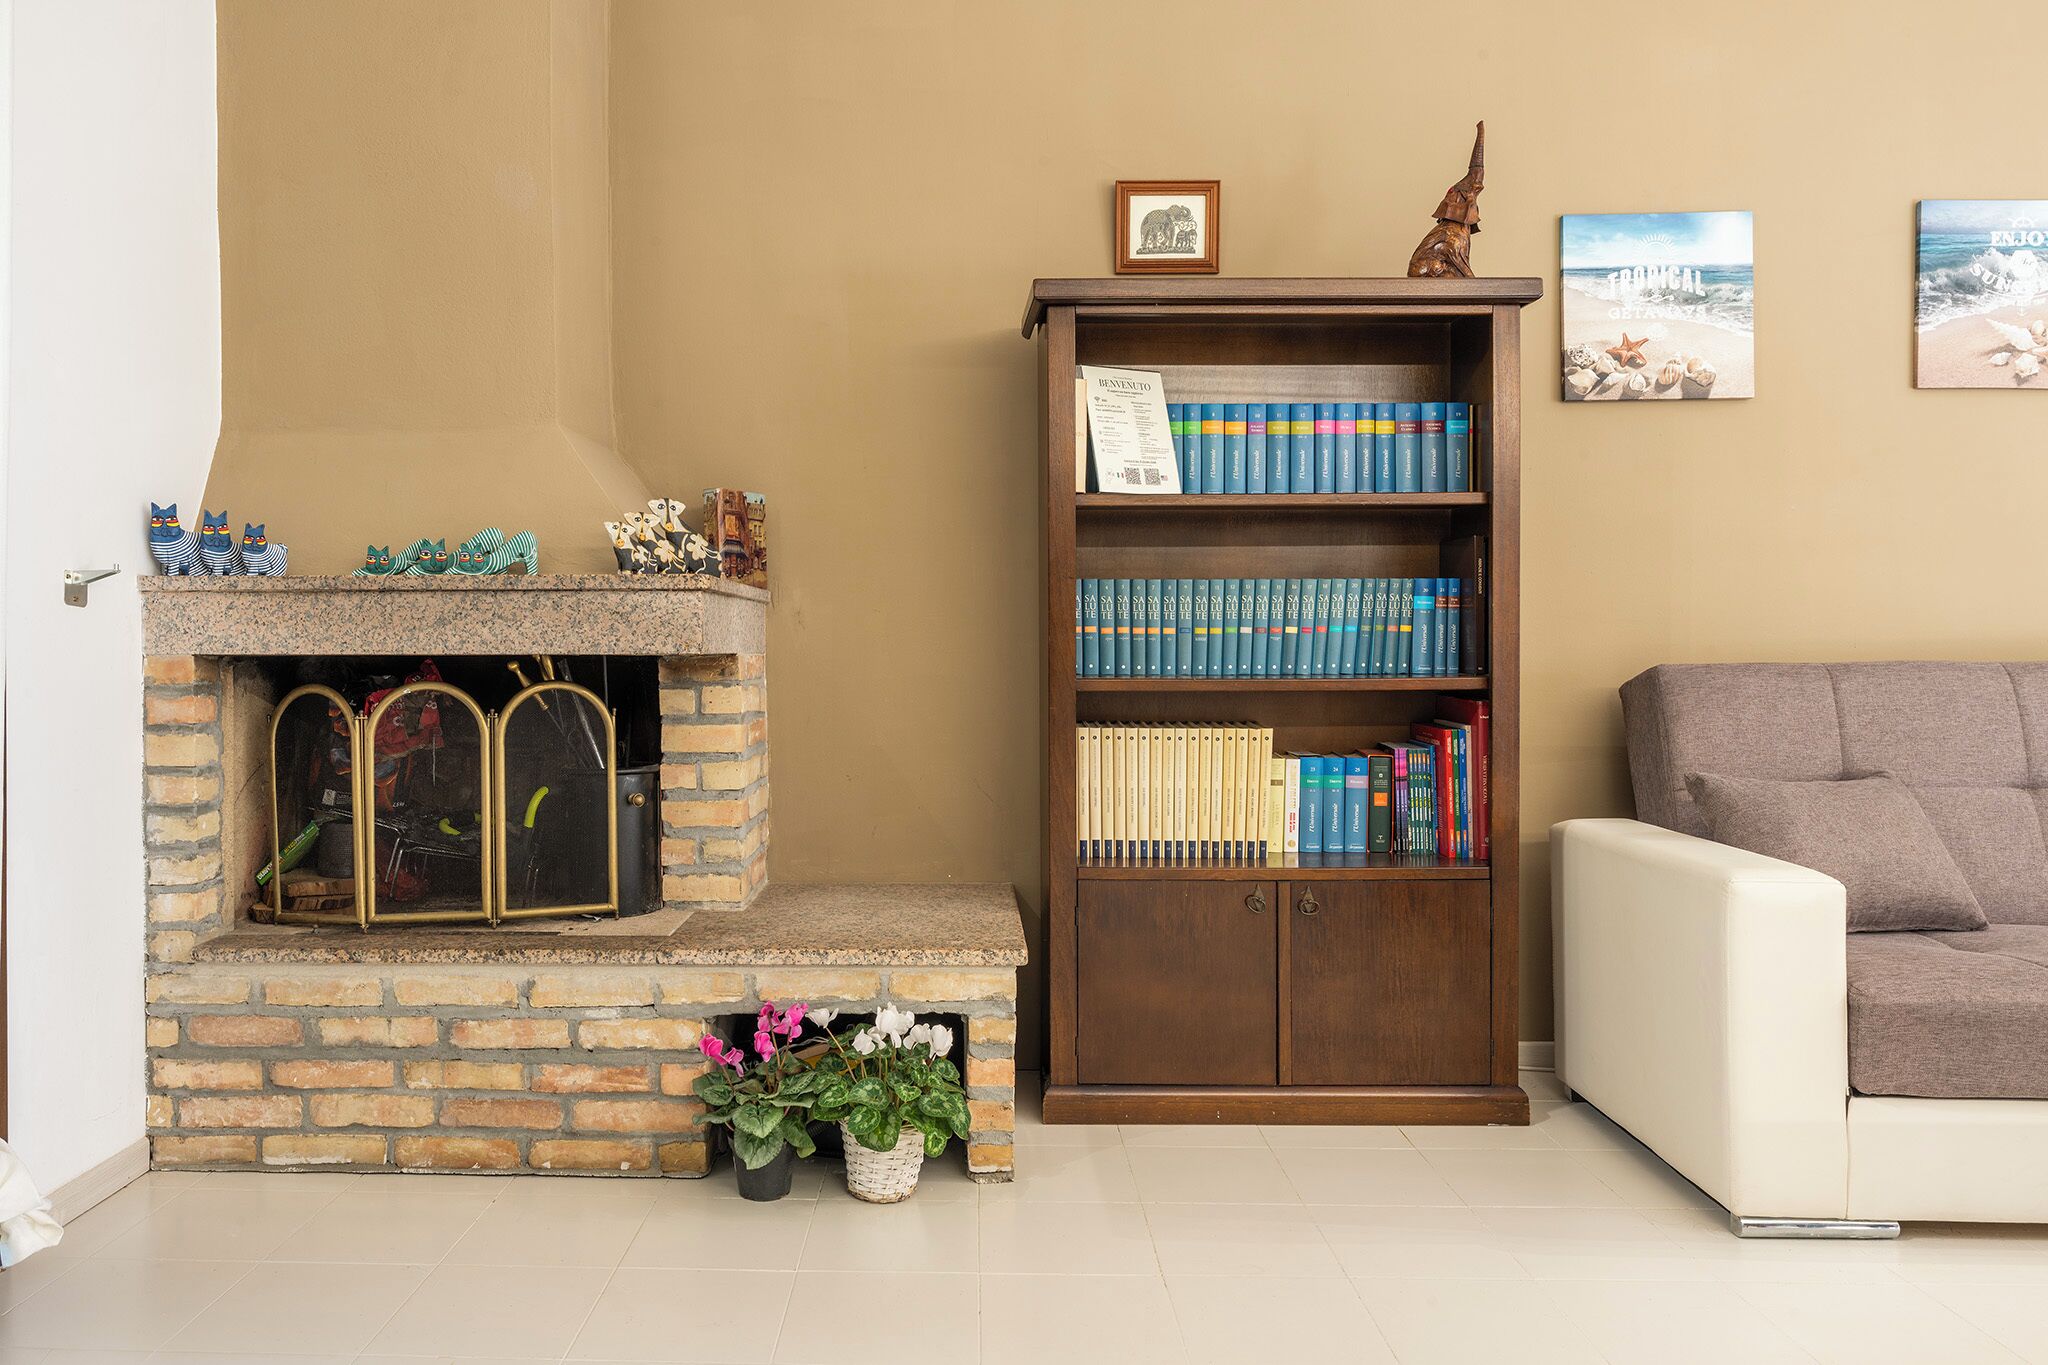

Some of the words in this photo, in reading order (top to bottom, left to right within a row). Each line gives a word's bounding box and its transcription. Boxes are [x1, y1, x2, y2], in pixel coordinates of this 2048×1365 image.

[1990, 230, 2048, 247] ENJO
[1607, 264, 1706, 297] TROPICAL
[1098, 378, 1151, 391] BENVENUTO
[1084, 594, 1096, 602] SA
[1101, 596, 1113, 604] SA
[1118, 595, 1129, 603] SA
[1132, 596, 1145, 604] SA
[1148, 596, 1160, 604] SA
[1164, 596, 1176, 604] SA
[1180, 594, 1192, 604] SA
[1196, 596, 1208, 604] SA
[1211, 596, 1222, 604] SA
[1226, 594, 1238, 602] SA
[1242, 594, 1254, 603] SA
[1257, 594, 1268, 603] SA
[1272, 594, 1284, 603] SA
[1288, 594, 1299, 602] SA
[1303, 594, 1314, 603] SA
[1318, 594, 1330, 602] SA
[1332, 594, 1344, 602] SA
[1348, 592, 1360, 602] SA
[1363, 592, 1374, 602] SA
[1376, 592, 1388, 601] SA
[1390, 592, 1400, 601] SA
[1402, 592, 1413, 602] SA
[1084, 602, 1096, 610] LU
[1211, 604, 1222, 612] LU
[1226, 602, 1238, 610] LU
[1242, 603, 1254, 611] LU
[1272, 603, 1284, 611] LU
[1288, 602, 1299, 610] LU
[1303, 603, 1314, 611] LU
[1332, 602, 1344, 610] LU
[1348, 602, 1360, 610] LU
[1390, 601, 1400, 609] LU
[1084, 610, 1096, 618] TE
[1101, 611, 1113, 620] TE
[1118, 610, 1129, 619] TE
[1132, 611, 1145, 620] TE
[1148, 611, 1160, 620] TE
[1164, 611, 1176, 620] TE
[1180, 611, 1192, 620] TE
[1196, 611, 1208, 620] TE
[1211, 612, 1222, 620] TE
[1226, 610, 1238, 619] TE
[1242, 611, 1254, 620] TE
[1257, 610, 1268, 620] TE
[1272, 611, 1284, 619] TE
[1288, 610, 1299, 619] TE
[1303, 611, 1314, 620] TE
[1318, 610, 1330, 618] TE
[1332, 610, 1344, 618] TE
[1348, 610, 1360, 618] TE
[1363, 609, 1374, 618] TE
[1376, 608, 1388, 617] TE
[1390, 609, 1400, 618] TE
[1402, 609, 1413, 618] TE
